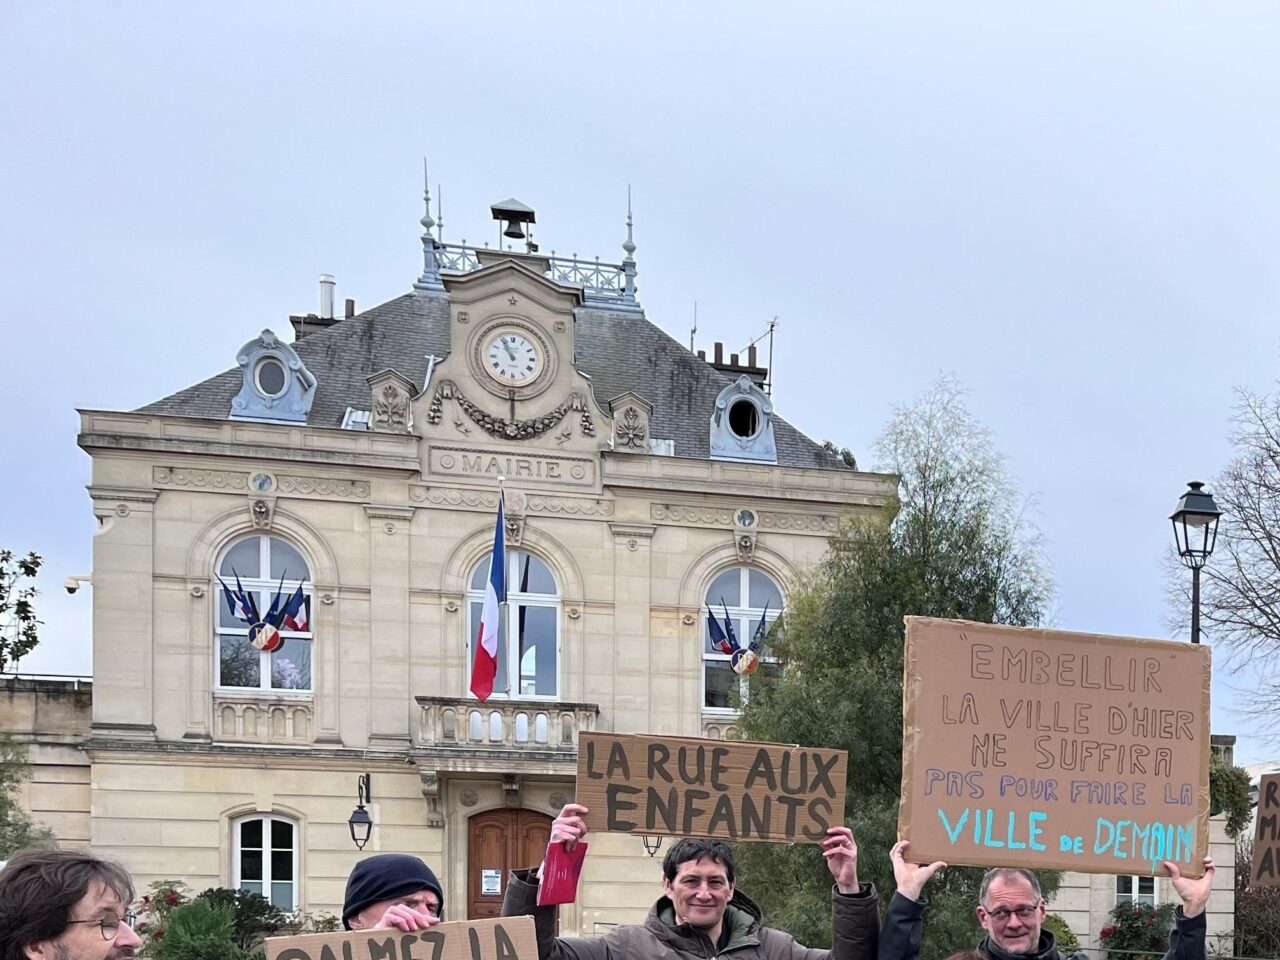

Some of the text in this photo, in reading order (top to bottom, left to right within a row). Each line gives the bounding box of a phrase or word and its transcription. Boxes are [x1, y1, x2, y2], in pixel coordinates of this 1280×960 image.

[462, 454, 562, 479] MAIRIE
[942, 692, 1194, 741] LA VILLE D'HIER
[587, 740, 839, 799] LA RUE AUX
[971, 733, 1173, 777] NE SUFFIRA
[925, 768, 1193, 806] PAS POUR FAIRE LA
[605, 783, 833, 841] ENFANTS
[938, 808, 1048, 850] VILLE
[1093, 816, 1195, 864] DEMAIN
